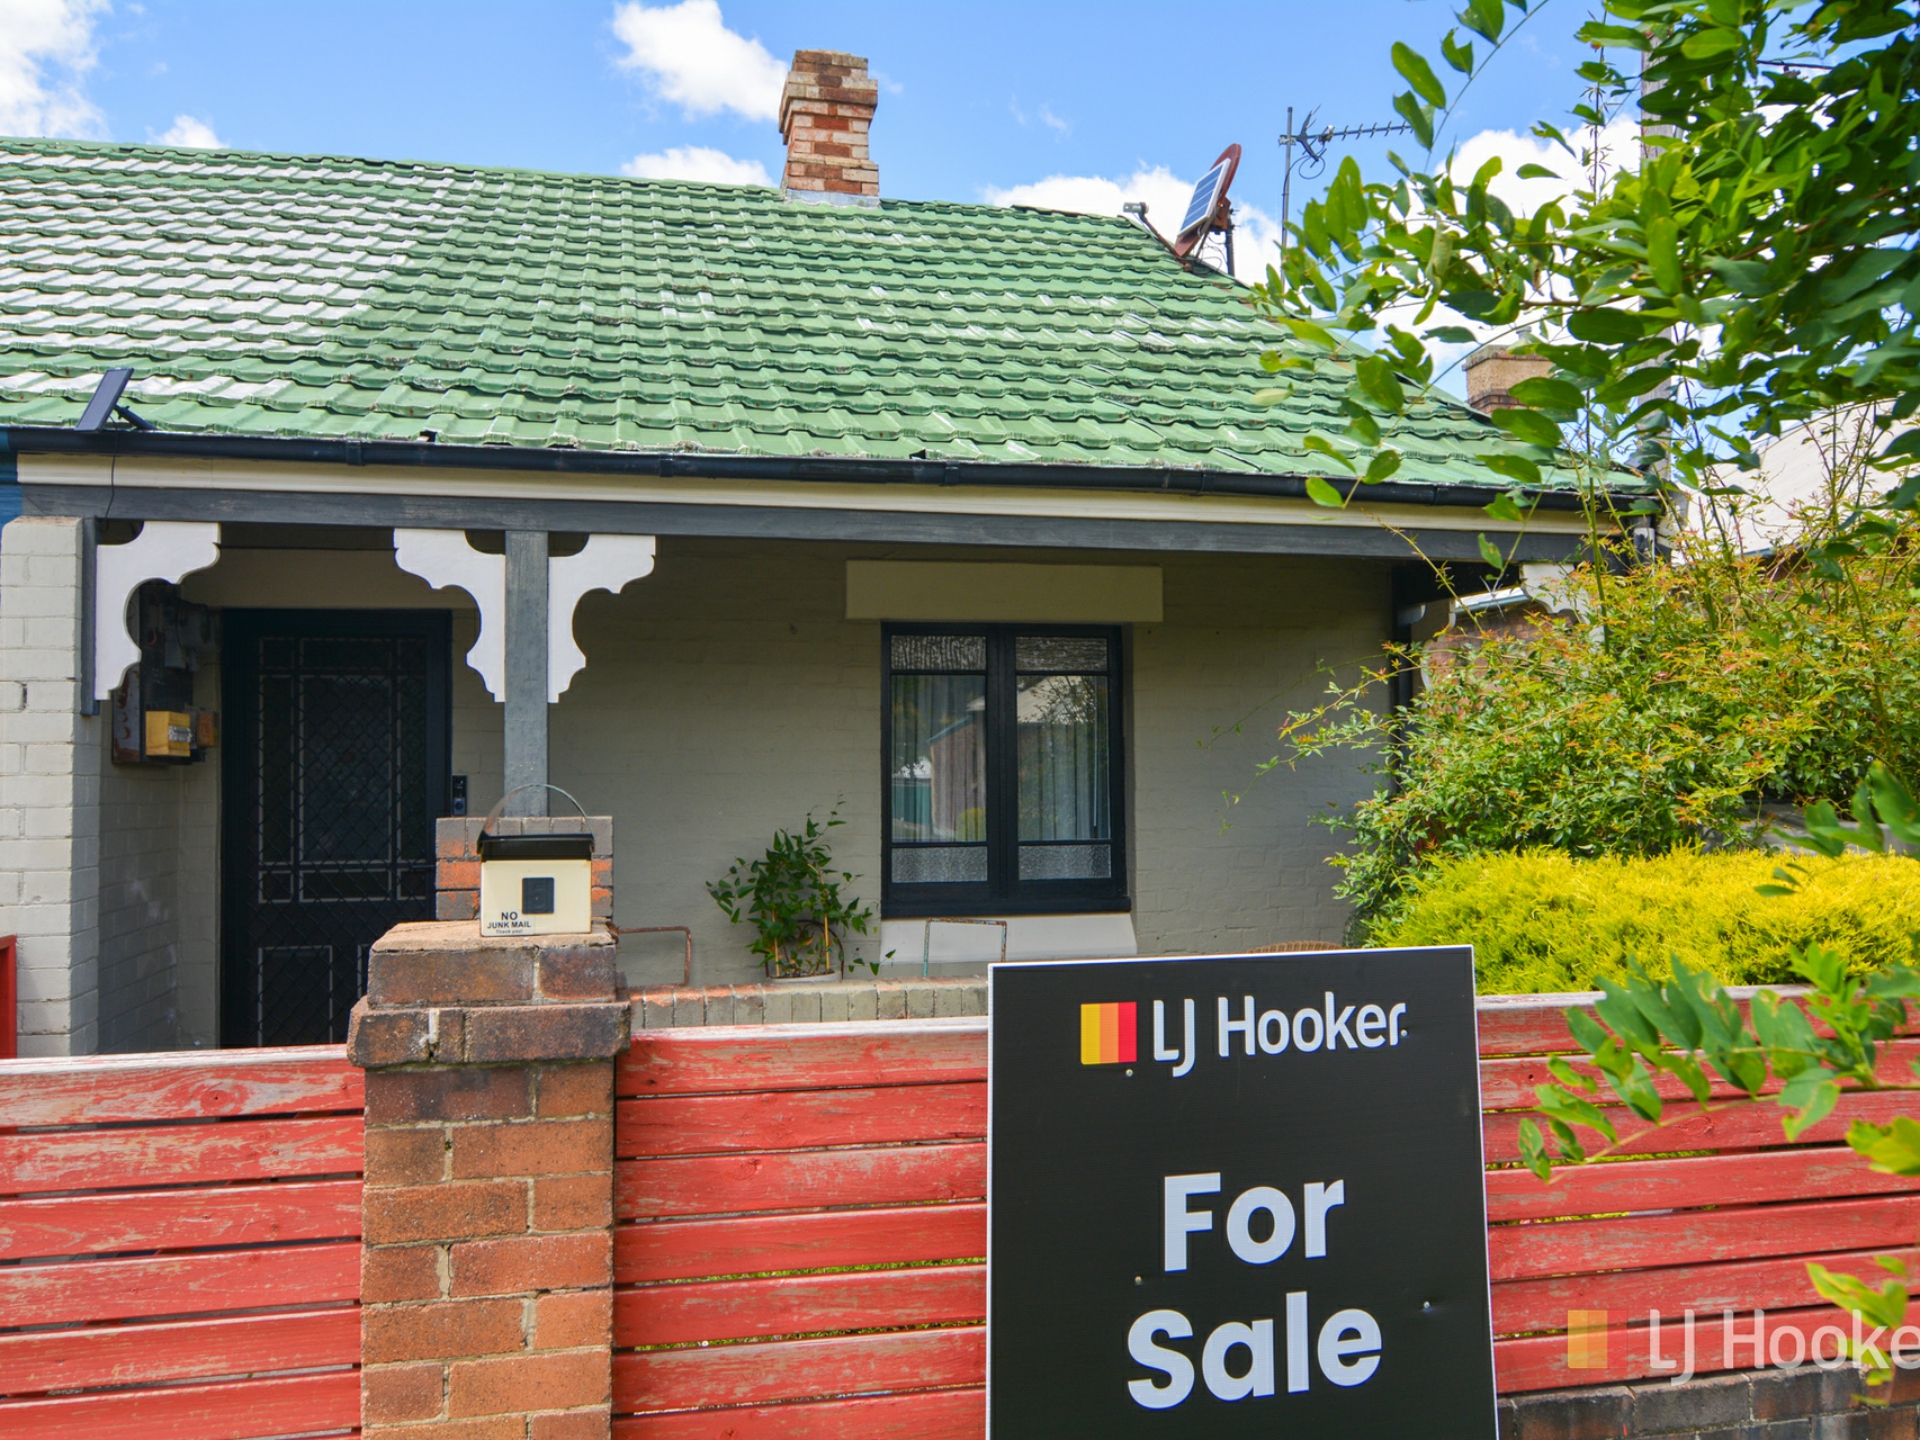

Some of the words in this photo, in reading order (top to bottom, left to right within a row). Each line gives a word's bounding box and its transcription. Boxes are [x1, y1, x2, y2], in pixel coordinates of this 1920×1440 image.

[501, 911, 518, 920] NO
[1153, 998, 1195, 1078] LJ
[1218, 991, 1406, 1057] Hooker
[1164, 1171, 1345, 1272] For
[1127, 1290, 1383, 1410] Sale
